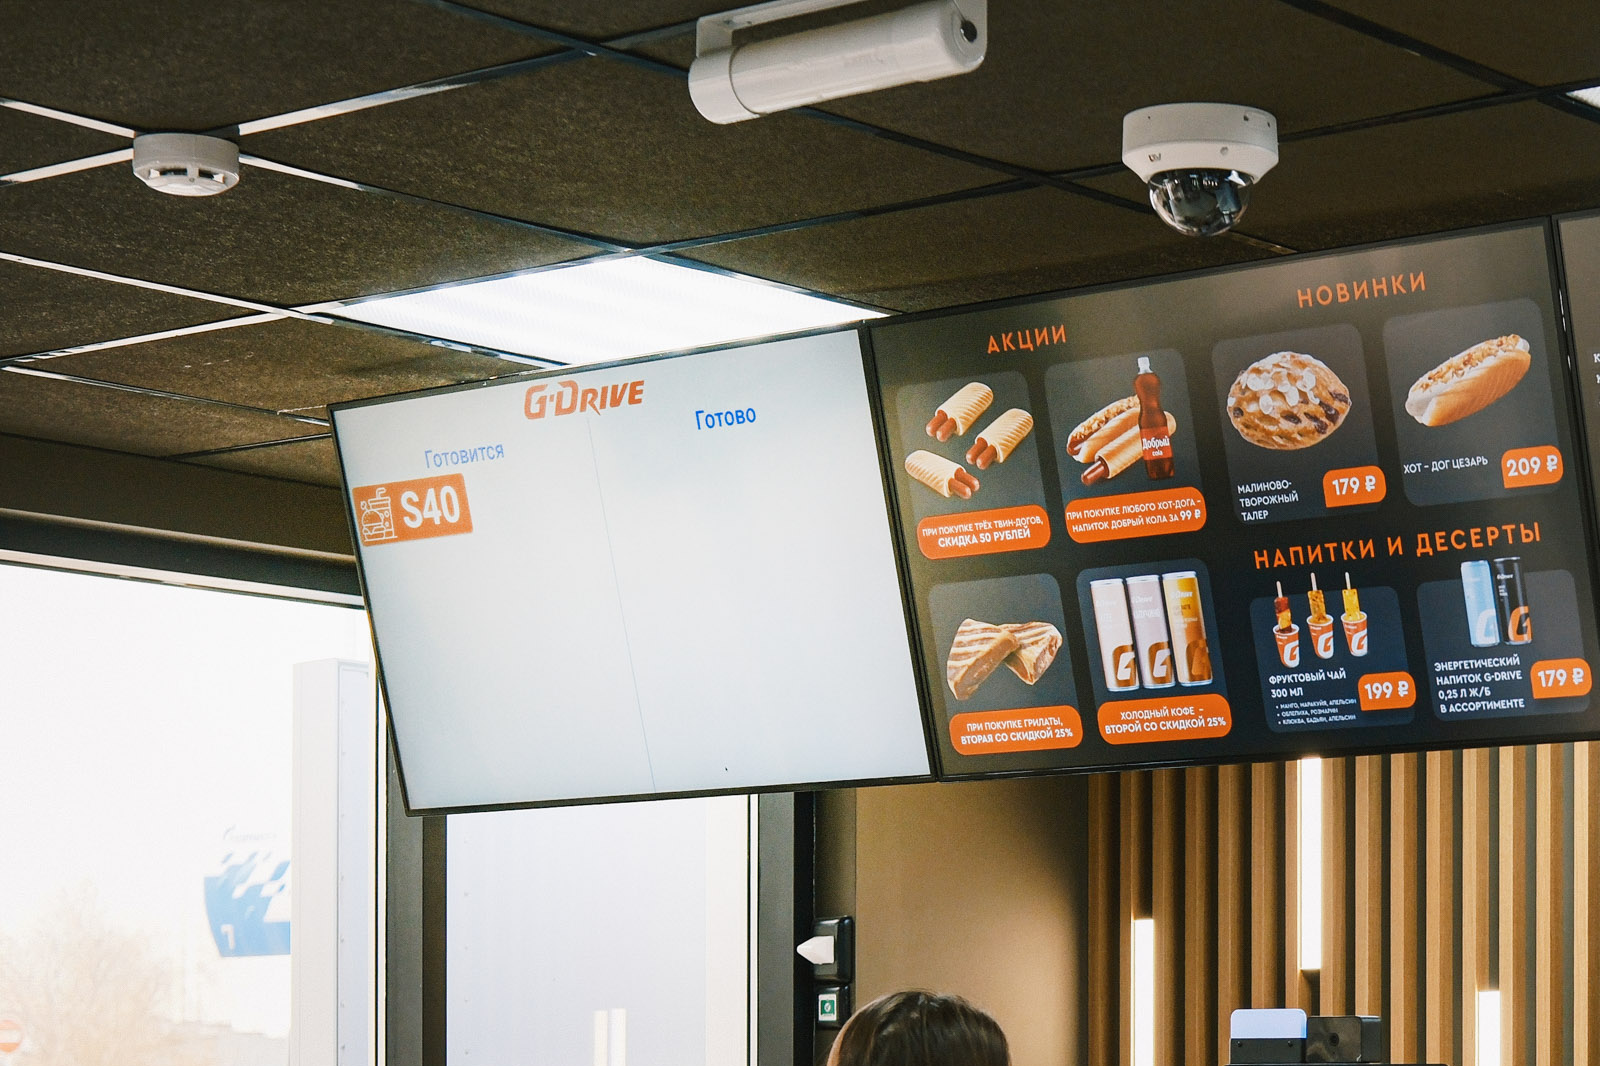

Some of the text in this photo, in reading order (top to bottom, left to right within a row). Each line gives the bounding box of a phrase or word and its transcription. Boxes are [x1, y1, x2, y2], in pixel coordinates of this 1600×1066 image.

[1298, 271, 1427, 308] НОВИНКИ
[988, 325, 1067, 354] АКЦИИ
[695, 408, 757, 431] Готово
[1142, 436, 1170, 450] Добрый
[424, 443, 505, 469] Готовится
[1404, 456, 1488, 474] ХОТ ДОГ ЦЕЗАРЬ
[1506, 456, 1541, 476] 209
[1238, 480, 1292, 494] МАЛИНОВО-
[1332, 476, 1359, 495] 179
[403, 485, 460, 528] S40
[1240, 491, 1298, 508] ТВОРОЖНЫЙ
[1072, 510, 1193, 532] НАПИТОК ДОБРЫЙ КОЛА ЗА 99
[1242, 510, 1268, 521] ТАЛЕР
[938, 527, 1030, 548] СКИДКА 50 РУБЛЕЙ
[1254, 522, 1541, 569] НАПИТКИ И ДЕСЕРТЫ
[1434, 654, 1520, 671] ЭНЕРГЕТИЧЕСКИЙ
[1269, 668, 1346, 684] ФРУКТОВЫЙ ЧАЙ
[1436, 669, 1522, 685] НАПИТОК G-DRIVE
[1538, 669, 1567, 688] 179
[1271, 687, 1303, 698] 300 МЛ
[1365, 682, 1392, 700] 199
[1438, 685, 1491, 701] 0,25 Л Ж/Б
[1120, 706, 1195, 720] ХОЛОДНЫЙ КОФЕ
[1441, 698, 1524, 713] В АССОРТИМЕНТЕ
[966, 716, 1063, 731] ПРИ ПОКУПКЕ ГРИЛАТЫ,
[1105, 717, 1226, 734] ВТОРОЙ СО СКИДКОЙ 25%
[961, 728, 1073, 745] ВТОРАЯ СО СКИДКОЙ 25%
